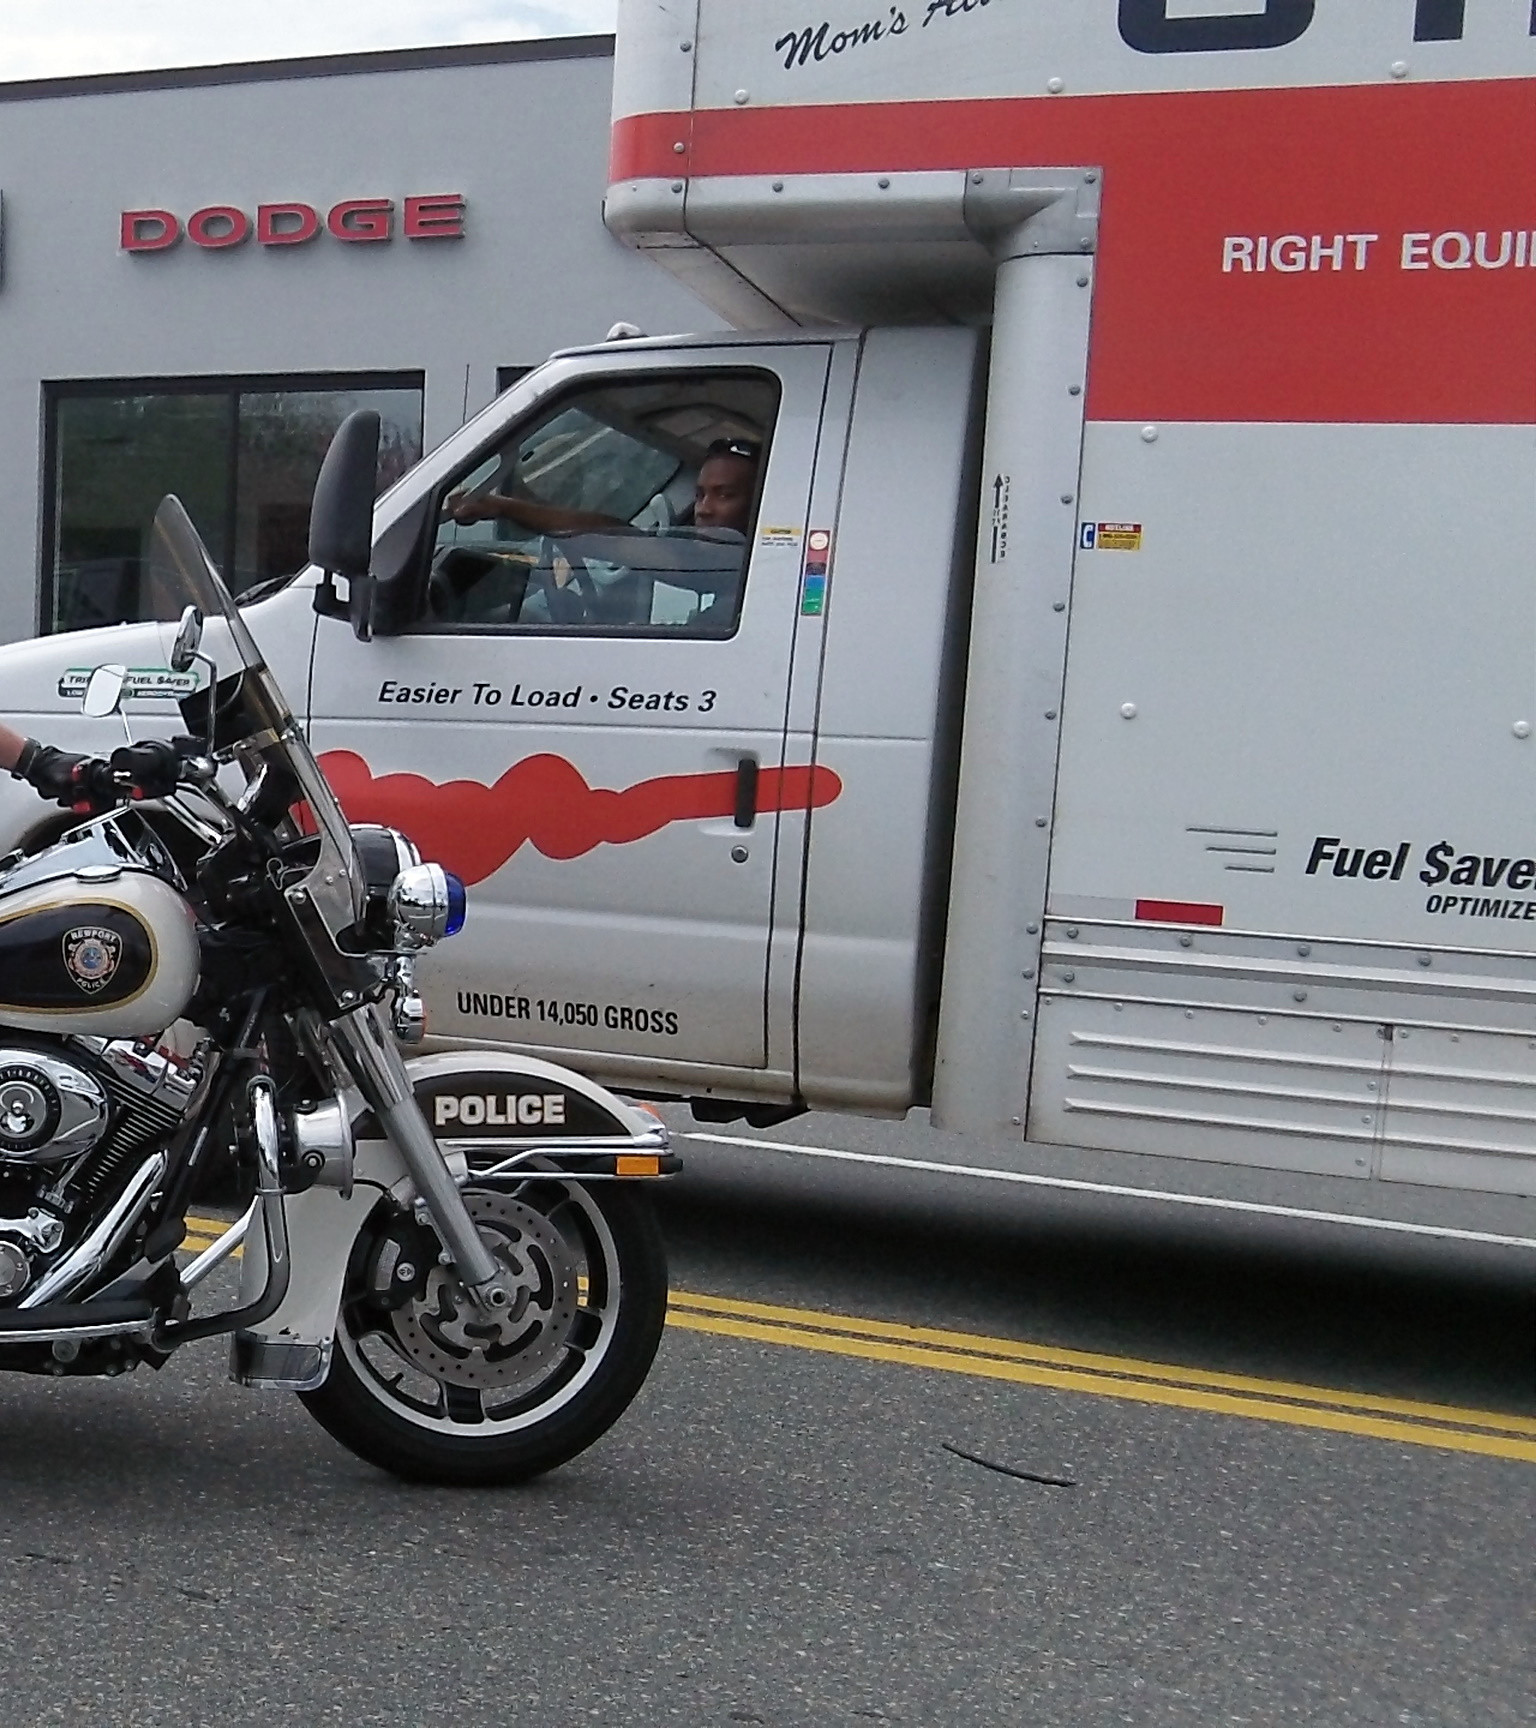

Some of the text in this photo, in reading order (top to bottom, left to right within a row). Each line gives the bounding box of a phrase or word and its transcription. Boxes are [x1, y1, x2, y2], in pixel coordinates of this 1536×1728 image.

[775, 7, 908, 69] Mom's
[119, 194, 465, 251] DODGE
[1222, 231, 1536, 272] RIGHT EQUI
[124, 676, 152, 684] FUEL
[156, 676, 190, 686] SAVER
[378, 681, 717, 713] Easier To Load Seats 3
[1305, 837, 1536, 890] Fuel $ave
[70, 929, 117, 942] NEWPORT
[457, 992, 678, 1035] UNDER 14,050 GROSS
[434, 1094, 565, 1126] POLICE
